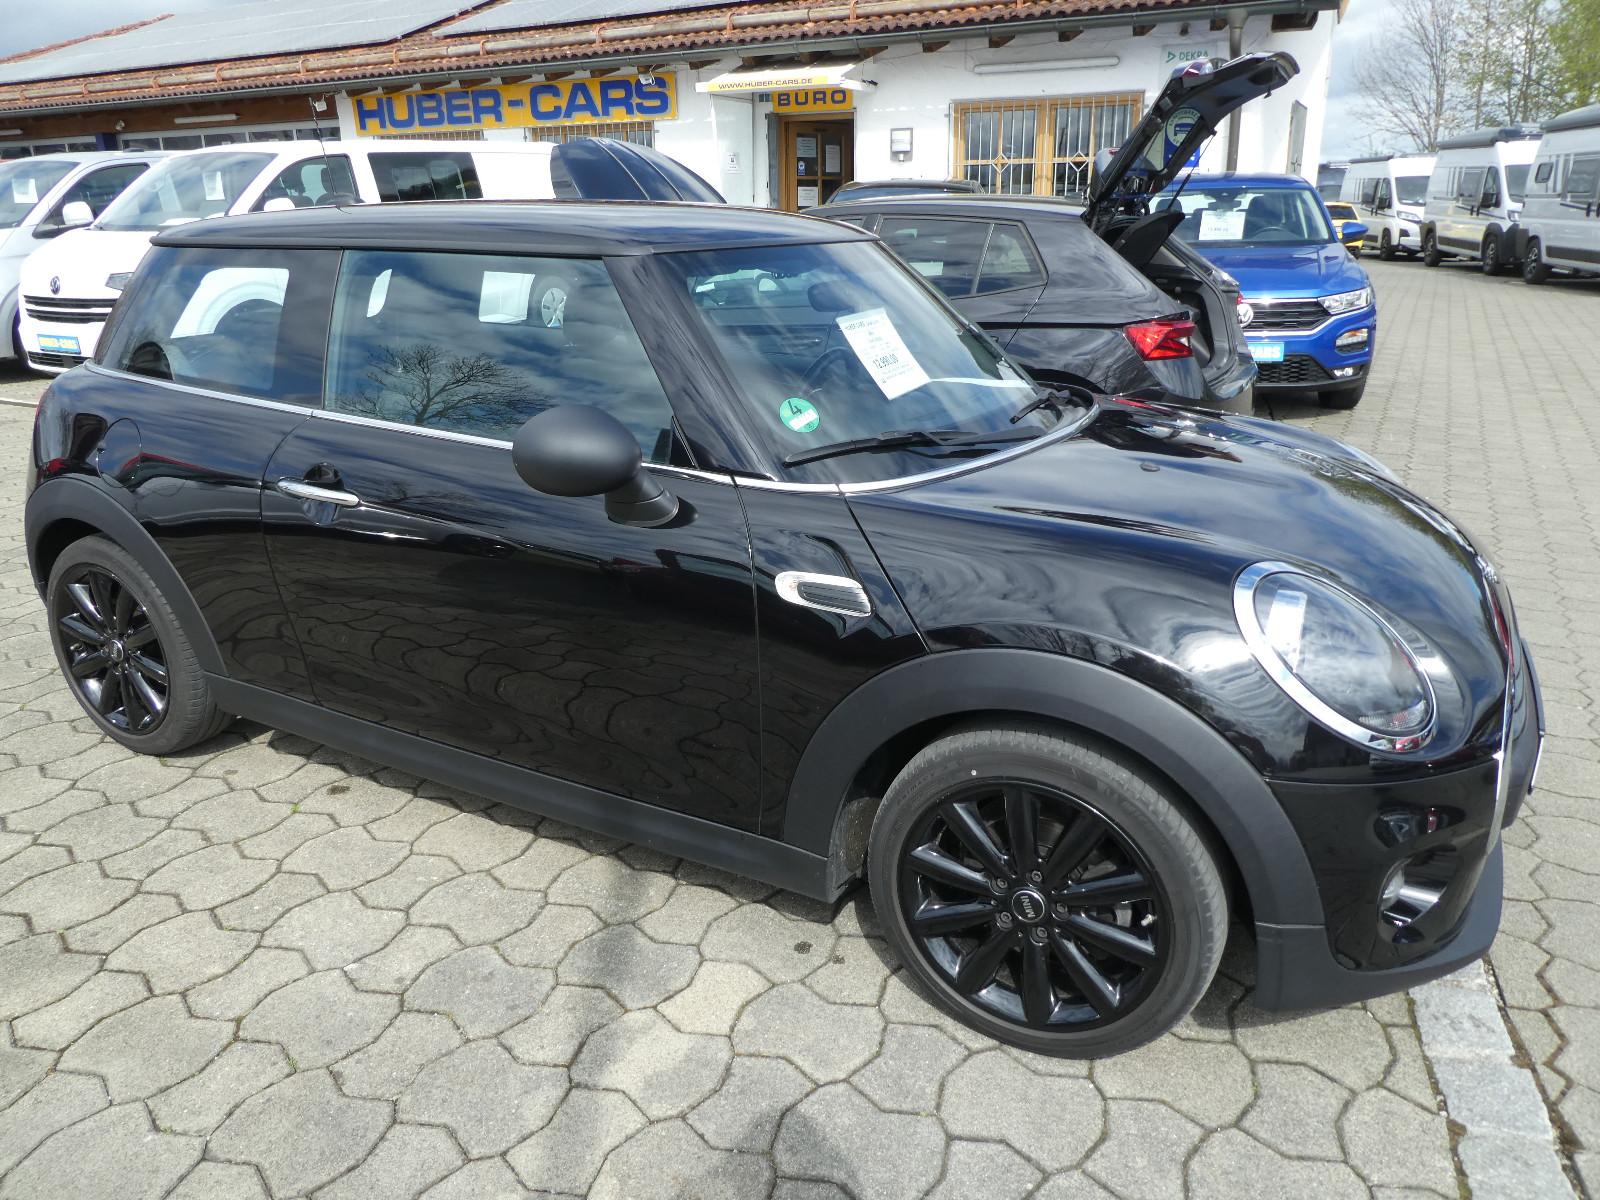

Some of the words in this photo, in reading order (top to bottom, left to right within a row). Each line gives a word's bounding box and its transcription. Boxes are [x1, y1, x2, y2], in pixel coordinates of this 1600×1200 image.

[356, 76, 669, 131] HUBER-CARS
[787, 400, 802, 415] 4
[1020, 895, 1036, 918] MINI
